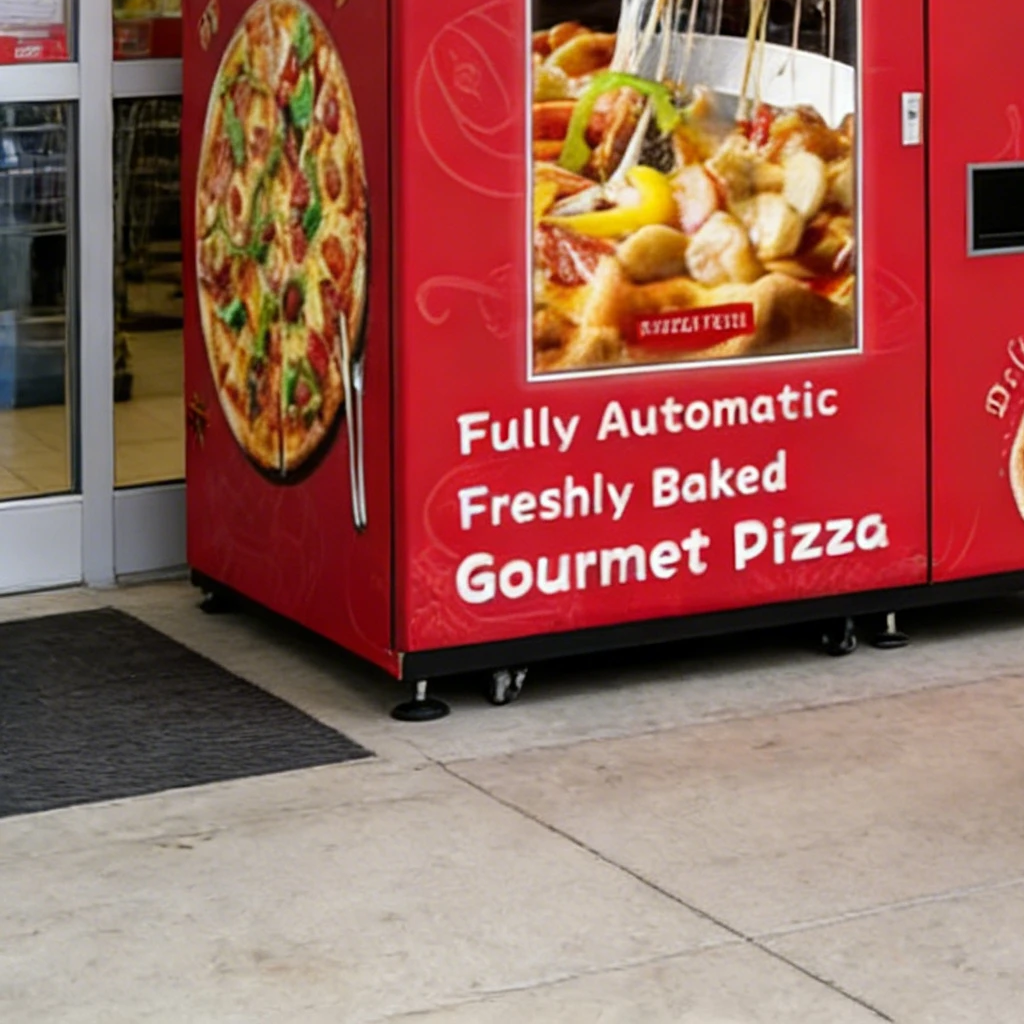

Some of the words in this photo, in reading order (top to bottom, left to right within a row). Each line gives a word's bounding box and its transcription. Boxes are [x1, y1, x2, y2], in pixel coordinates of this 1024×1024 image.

[456, 406, 580, 455] Fully
[596, 381, 839, 441] Automatic
[457, 472, 633, 530] Freshly
[651, 449, 787, 508] Baked
[455, 528, 711, 605] Gourmet
[734, 513, 889, 571] Pizza
